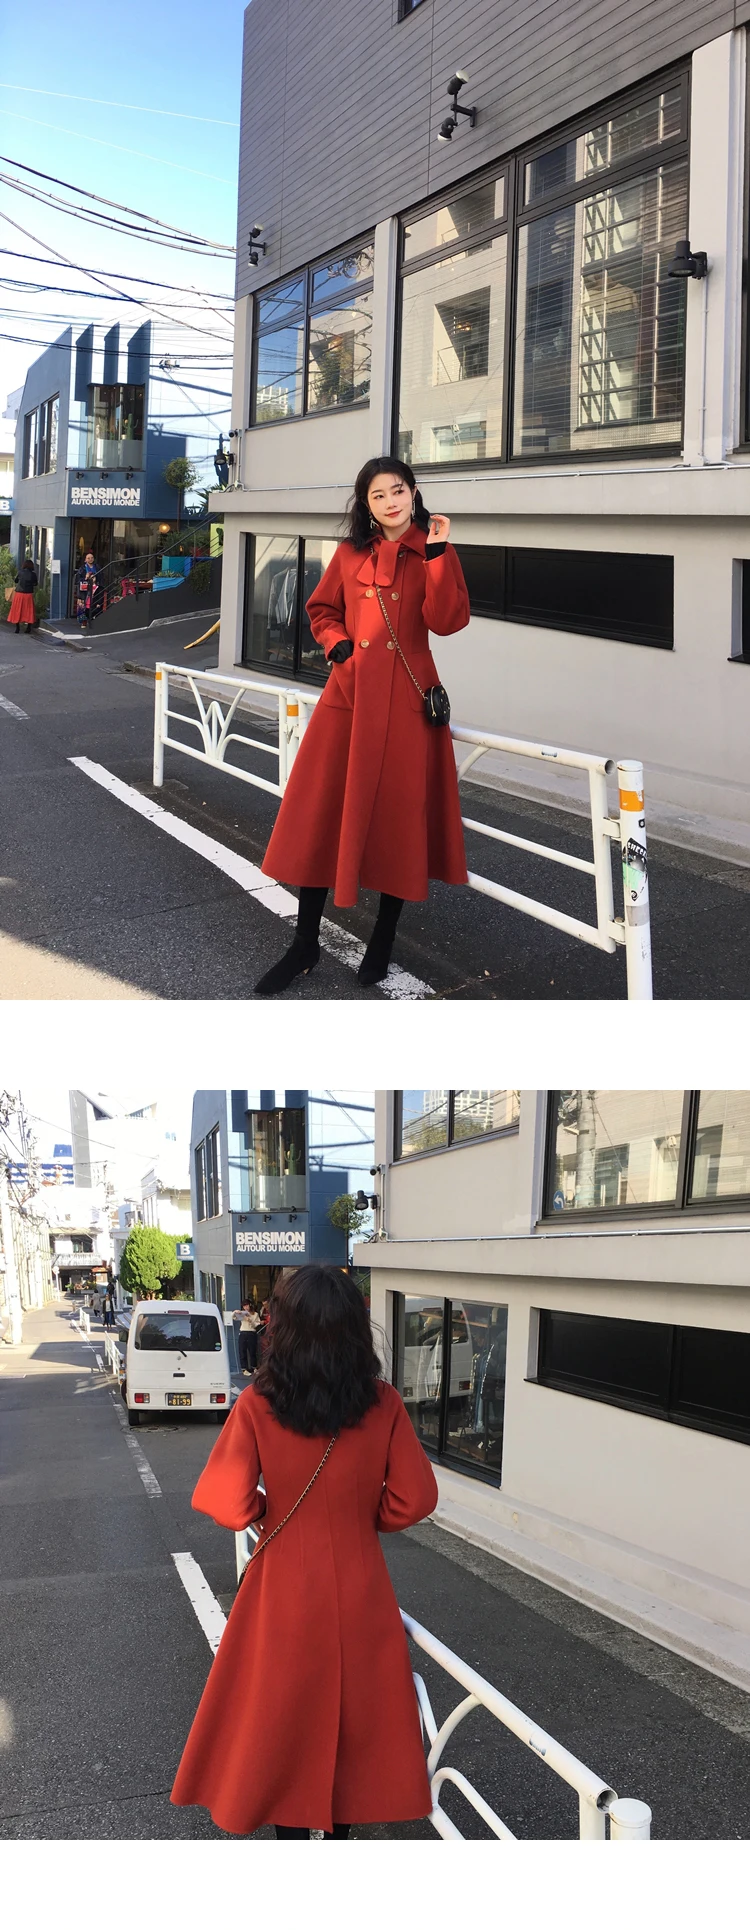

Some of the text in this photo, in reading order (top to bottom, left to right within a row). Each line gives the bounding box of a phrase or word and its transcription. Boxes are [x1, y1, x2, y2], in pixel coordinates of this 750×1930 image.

[71, 487, 140, 499] BENSIMON
[0, 500, 10, 510] B
[235, 1232, 305, 1245] BENSIMON
[180, 1244, 190, 1255] B
[172, 1398, 191, 1406] 81-99
